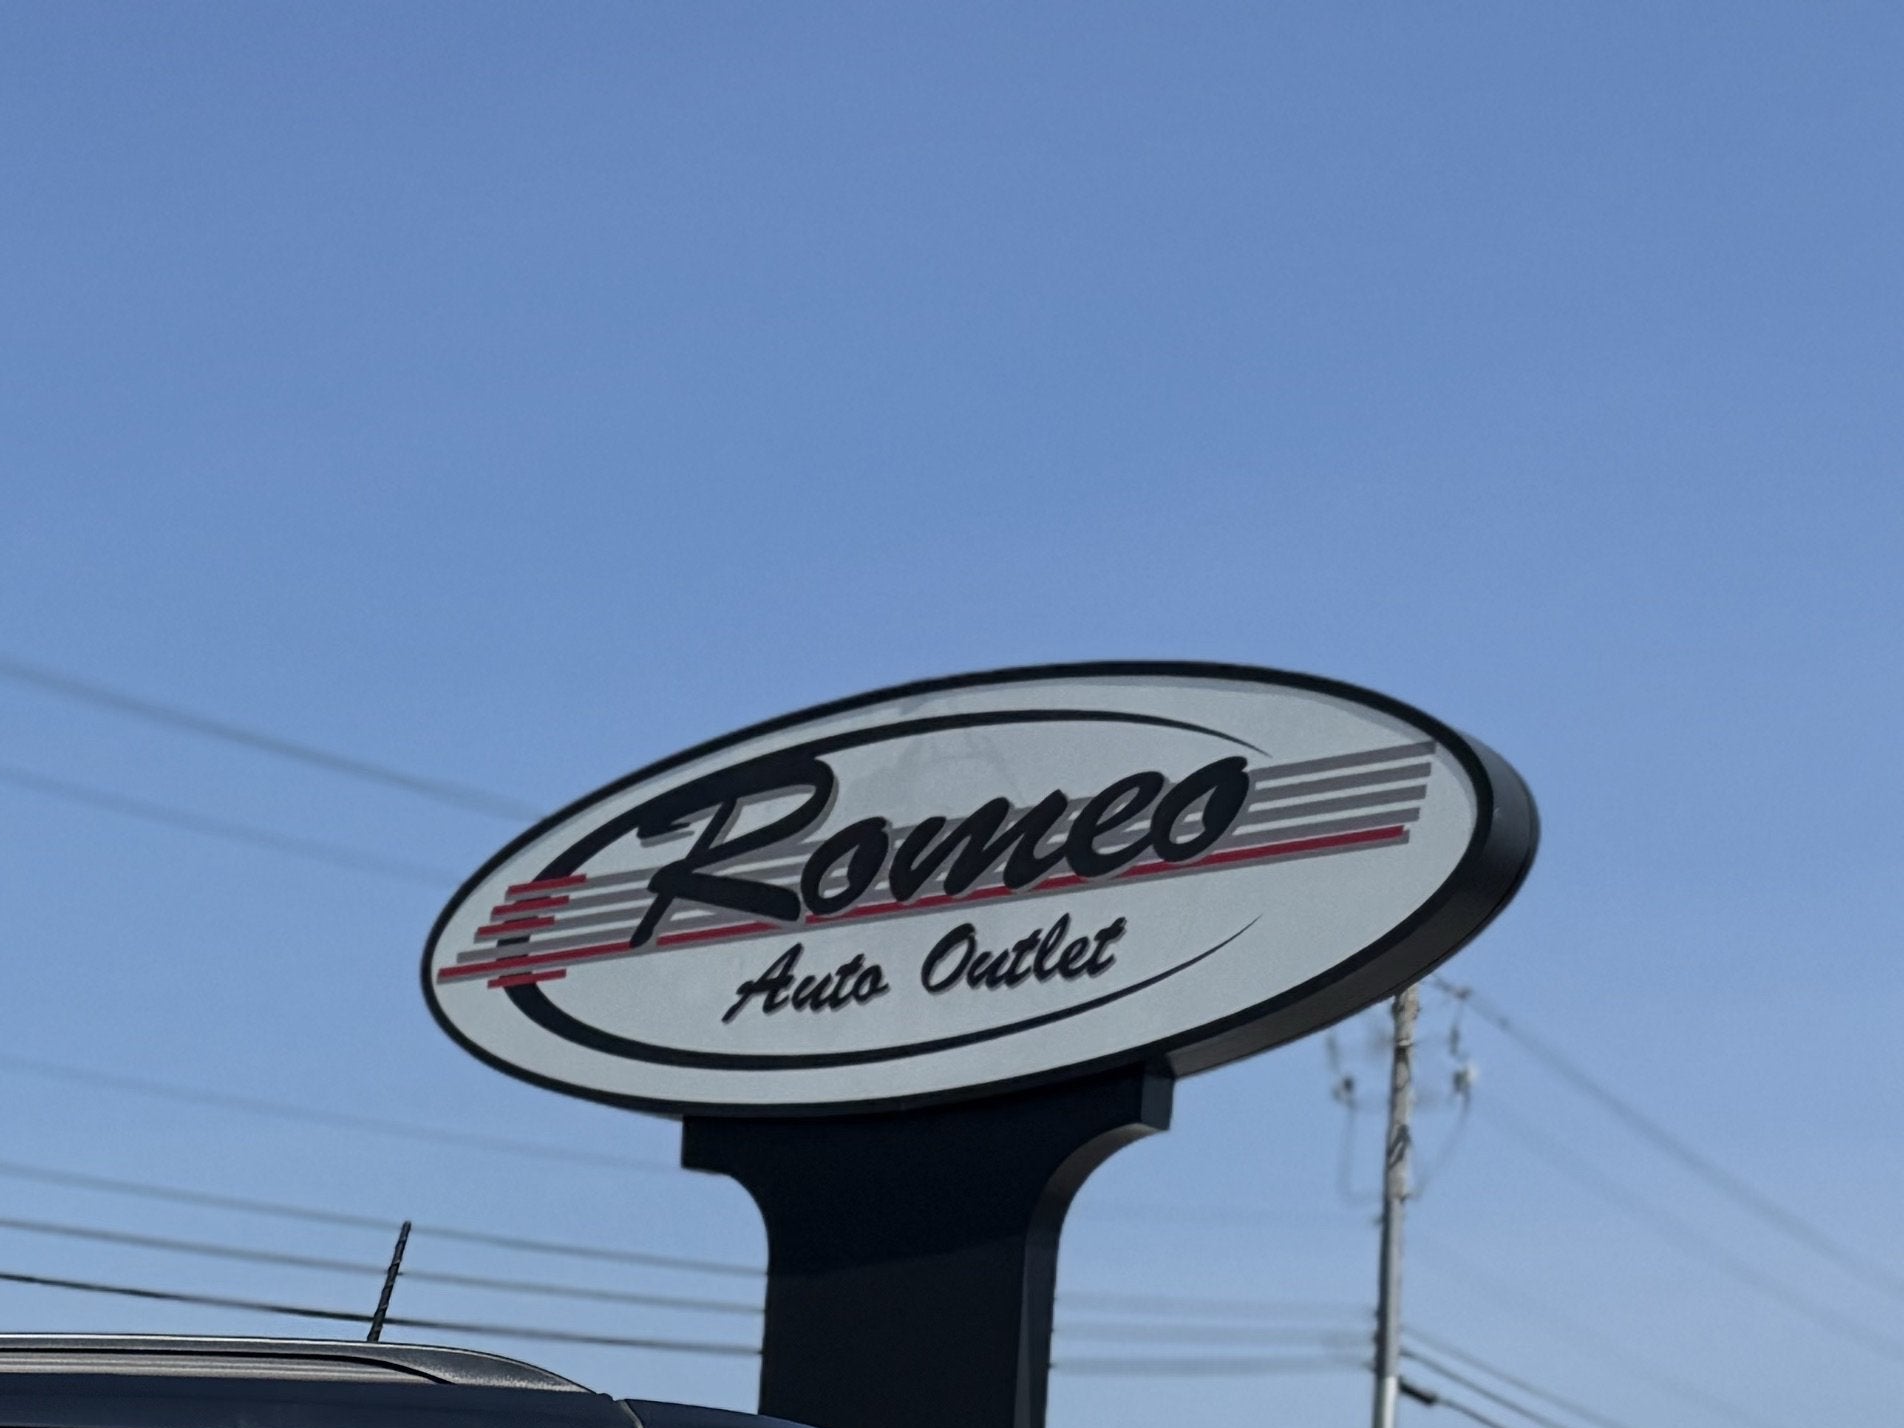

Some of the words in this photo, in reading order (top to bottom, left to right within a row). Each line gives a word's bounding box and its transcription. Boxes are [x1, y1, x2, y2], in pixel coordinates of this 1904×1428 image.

[622, 746, 1253, 948] Romeo
[722, 942, 889, 1025] Auto
[921, 912, 1127, 991] Outlet
